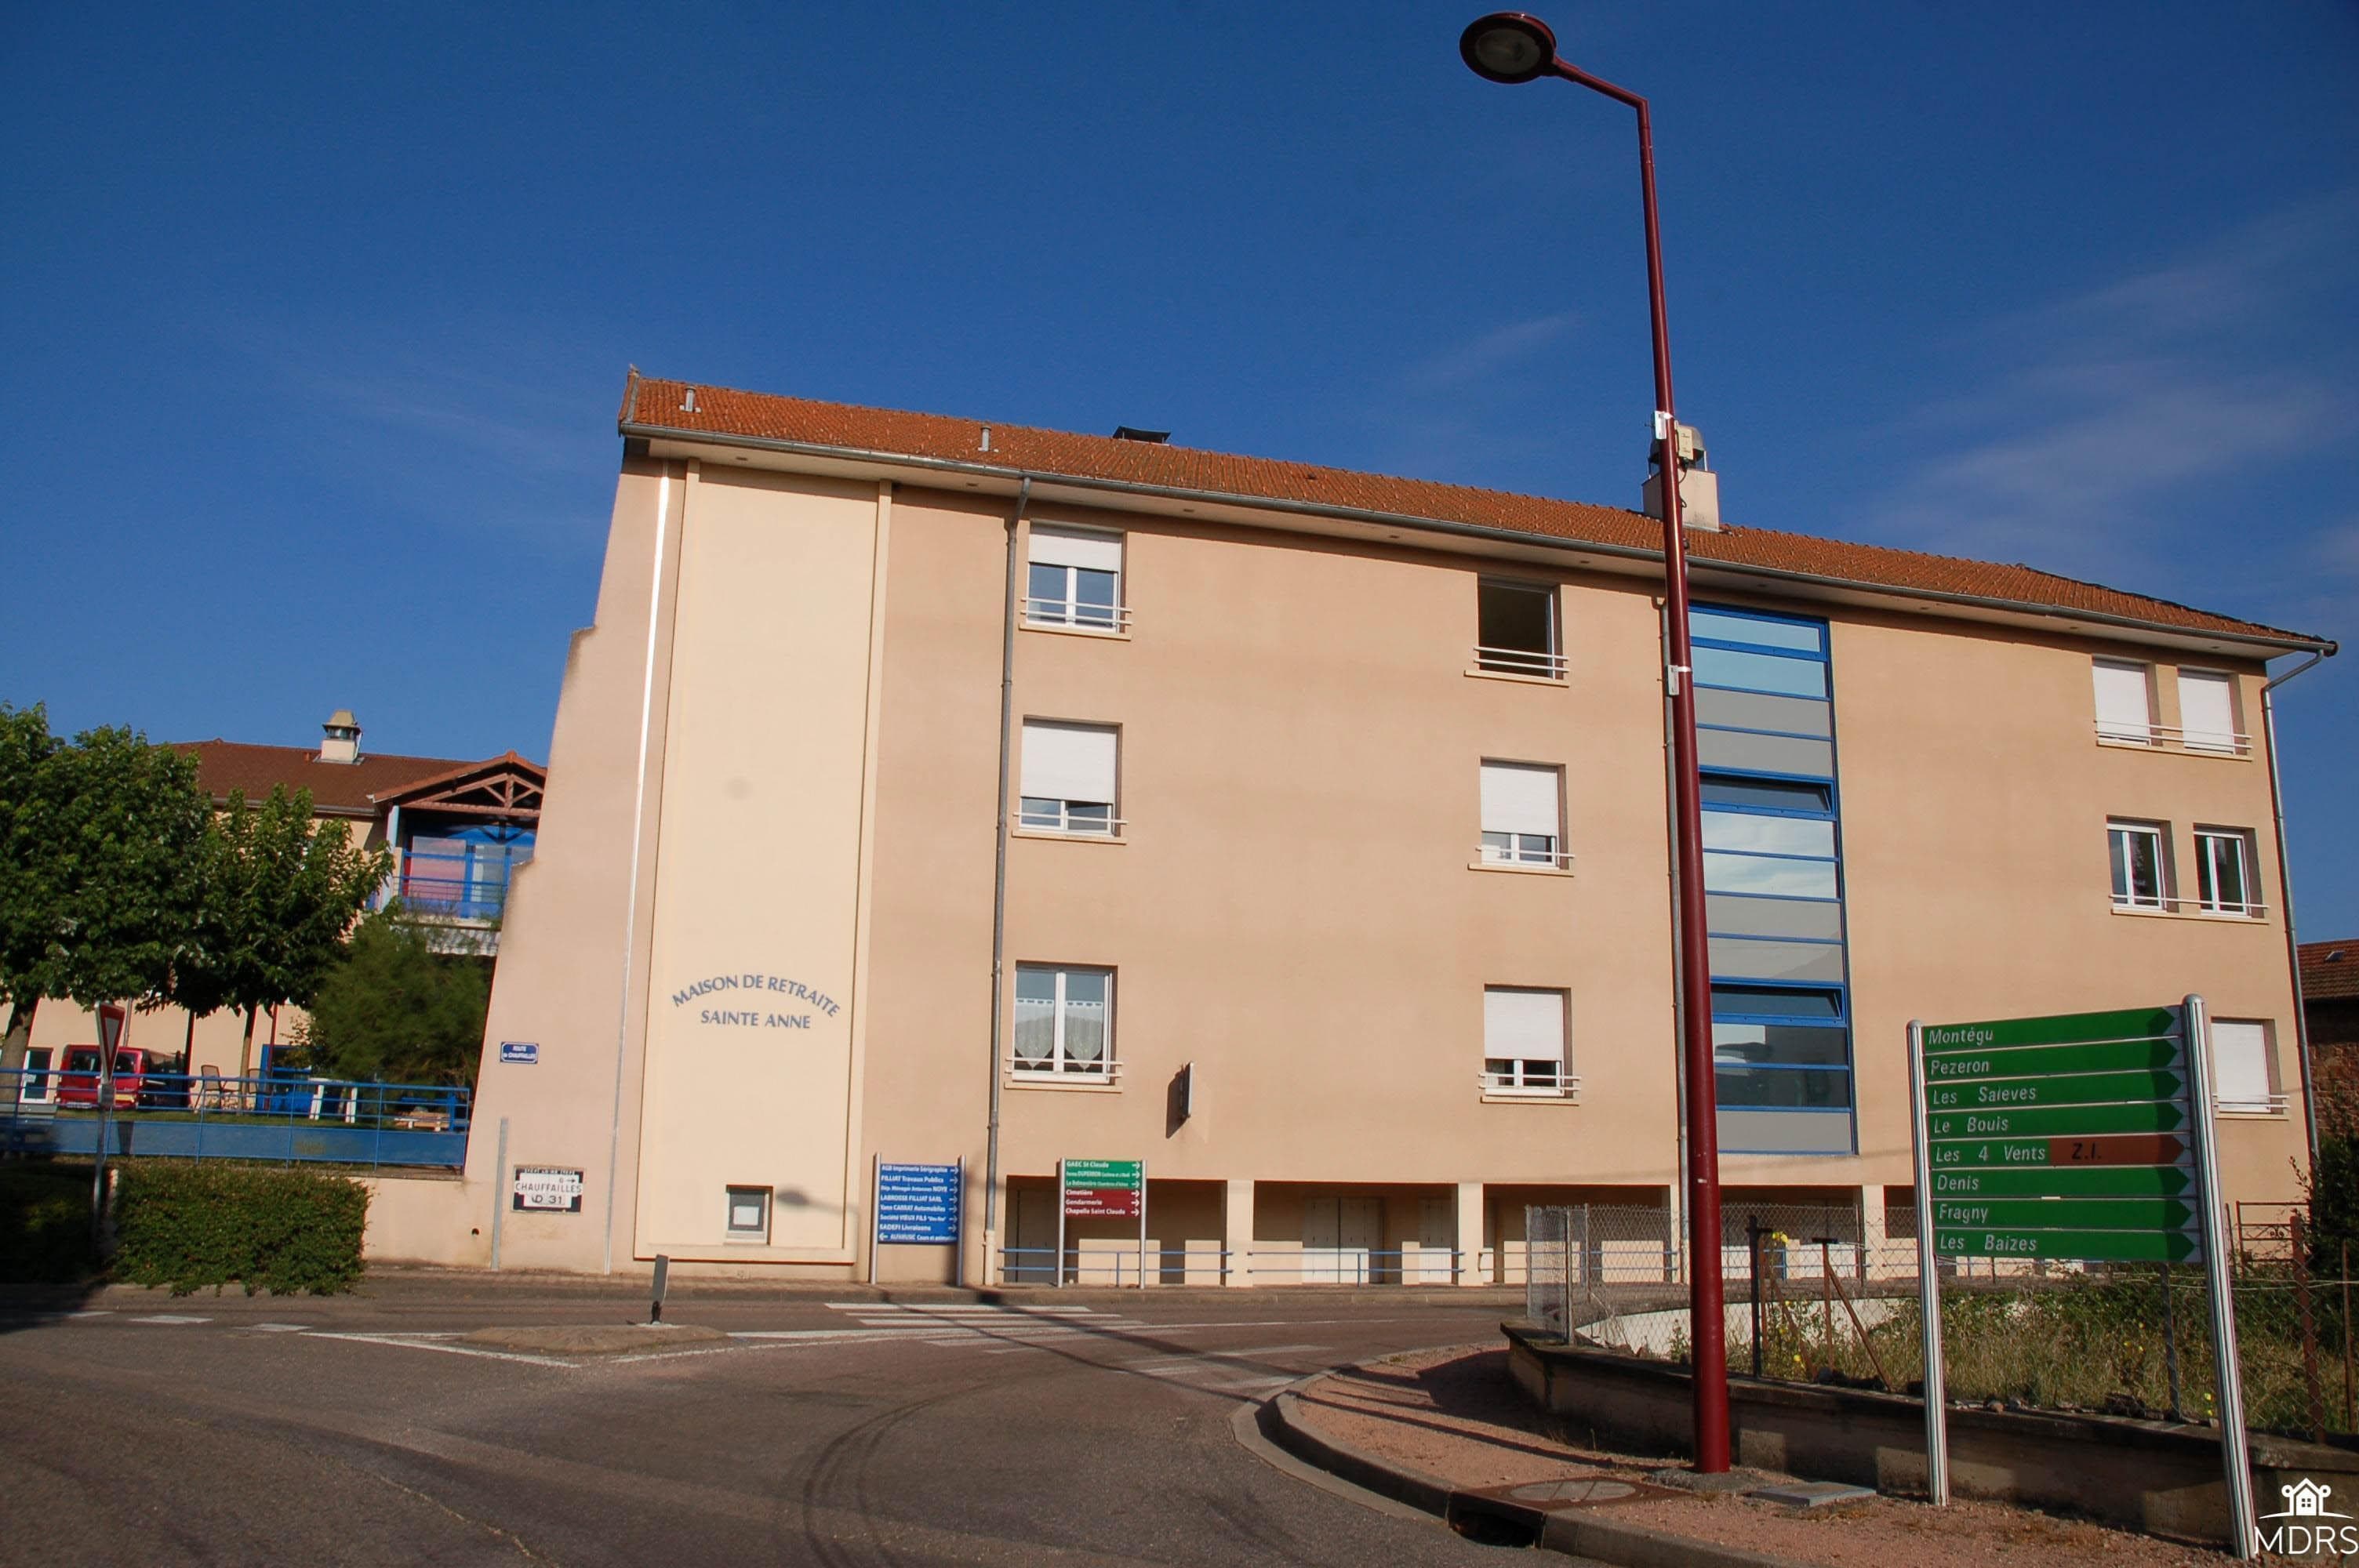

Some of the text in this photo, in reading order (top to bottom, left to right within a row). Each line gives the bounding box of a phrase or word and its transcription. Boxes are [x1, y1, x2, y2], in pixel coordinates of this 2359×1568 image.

[672, 974, 841, 1018] MAISON DE RETRAITE
[700, 1010, 811, 1029] SAINTE ANNE
[1928, 1027, 1994, 1046] Montégu
[1930, 1058, 1991, 1075] Pezeron
[1932, 1089, 1957, 1105] Les
[1935, 1116, 2009, 1133] Le Bouis
[1936, 1145, 2046, 1163] Les 4 Vents
[2071, 1142, 2102, 1161] Z.I.
[515, 1182, 582, 1193] CHAUFFAILLES
[1937, 1174, 1979, 1191] Denis
[549, 1195, 562, 1205] 31
[1939, 1204, 1988, 1222] Fragny
[1940, 1234, 2037, 1251] Les Baizes
